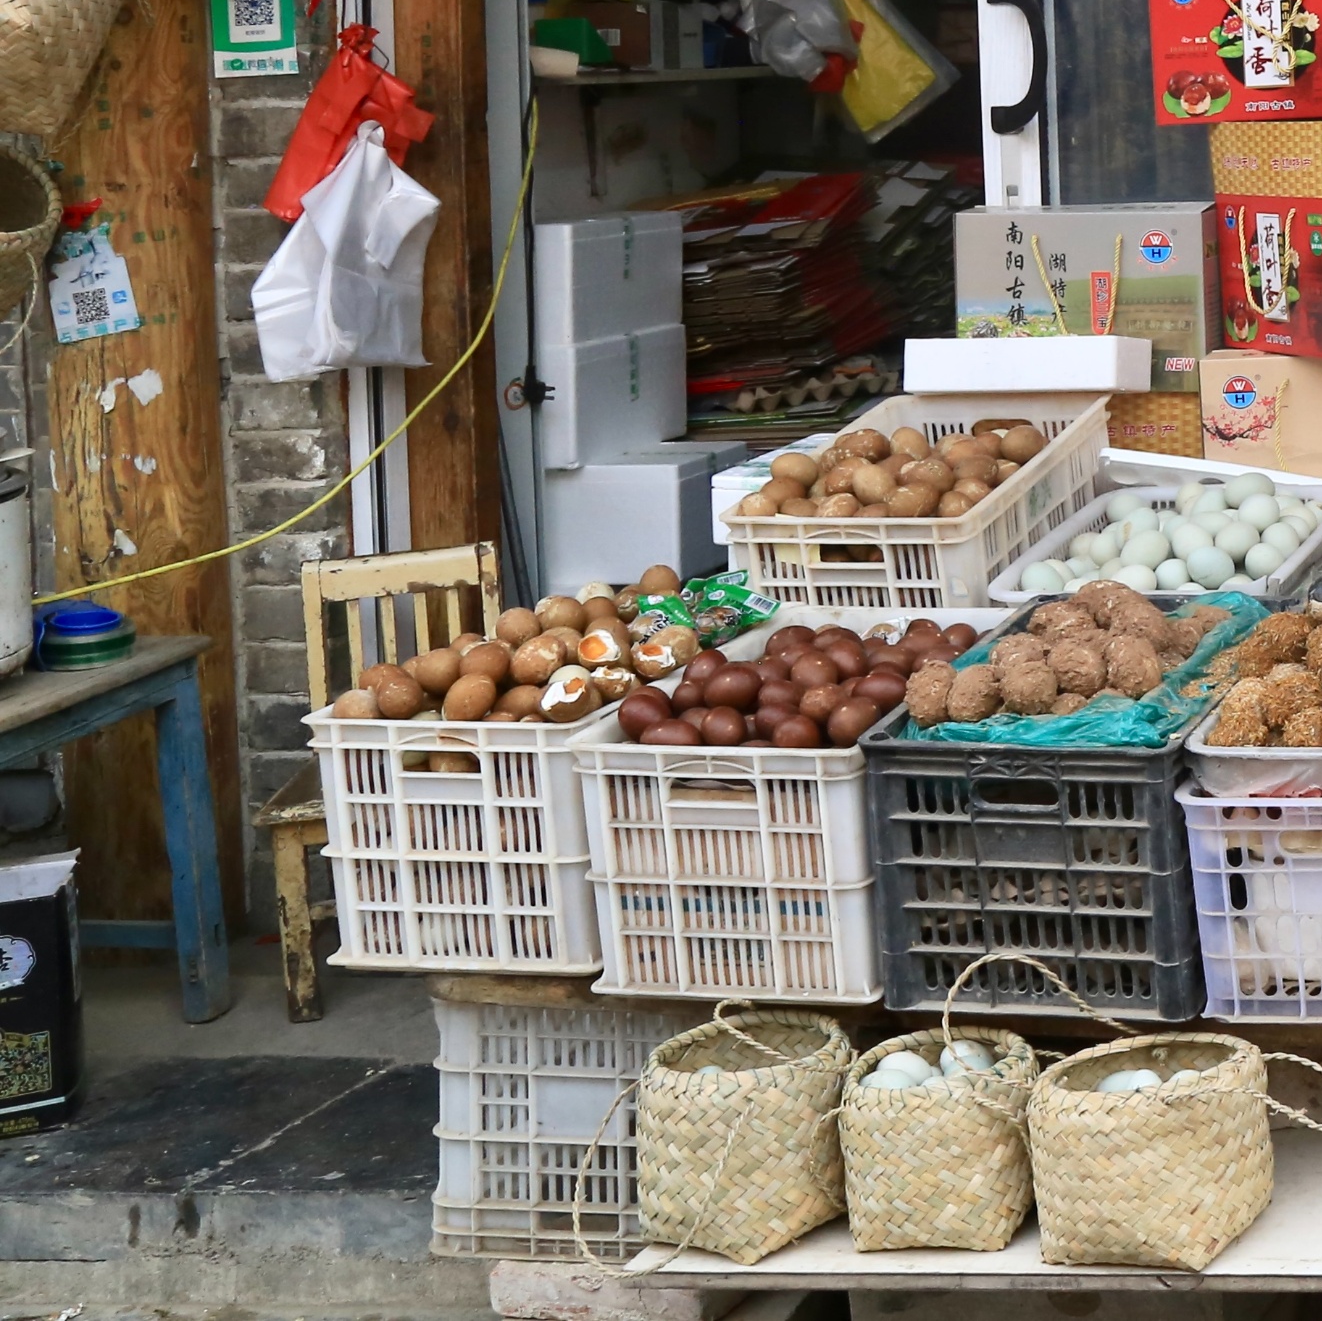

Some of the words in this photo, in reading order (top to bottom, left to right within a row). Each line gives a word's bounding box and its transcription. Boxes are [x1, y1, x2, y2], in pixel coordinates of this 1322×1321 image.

[1149, 235, 1163, 246] W
[1151, 248, 1162, 258] H
[1005, 221, 1029, 326] 南阳古镇
[1165, 358, 1195, 372] NEW
[1233, 381, 1247, 391] W
[1235, 394, 1245, 404] H
